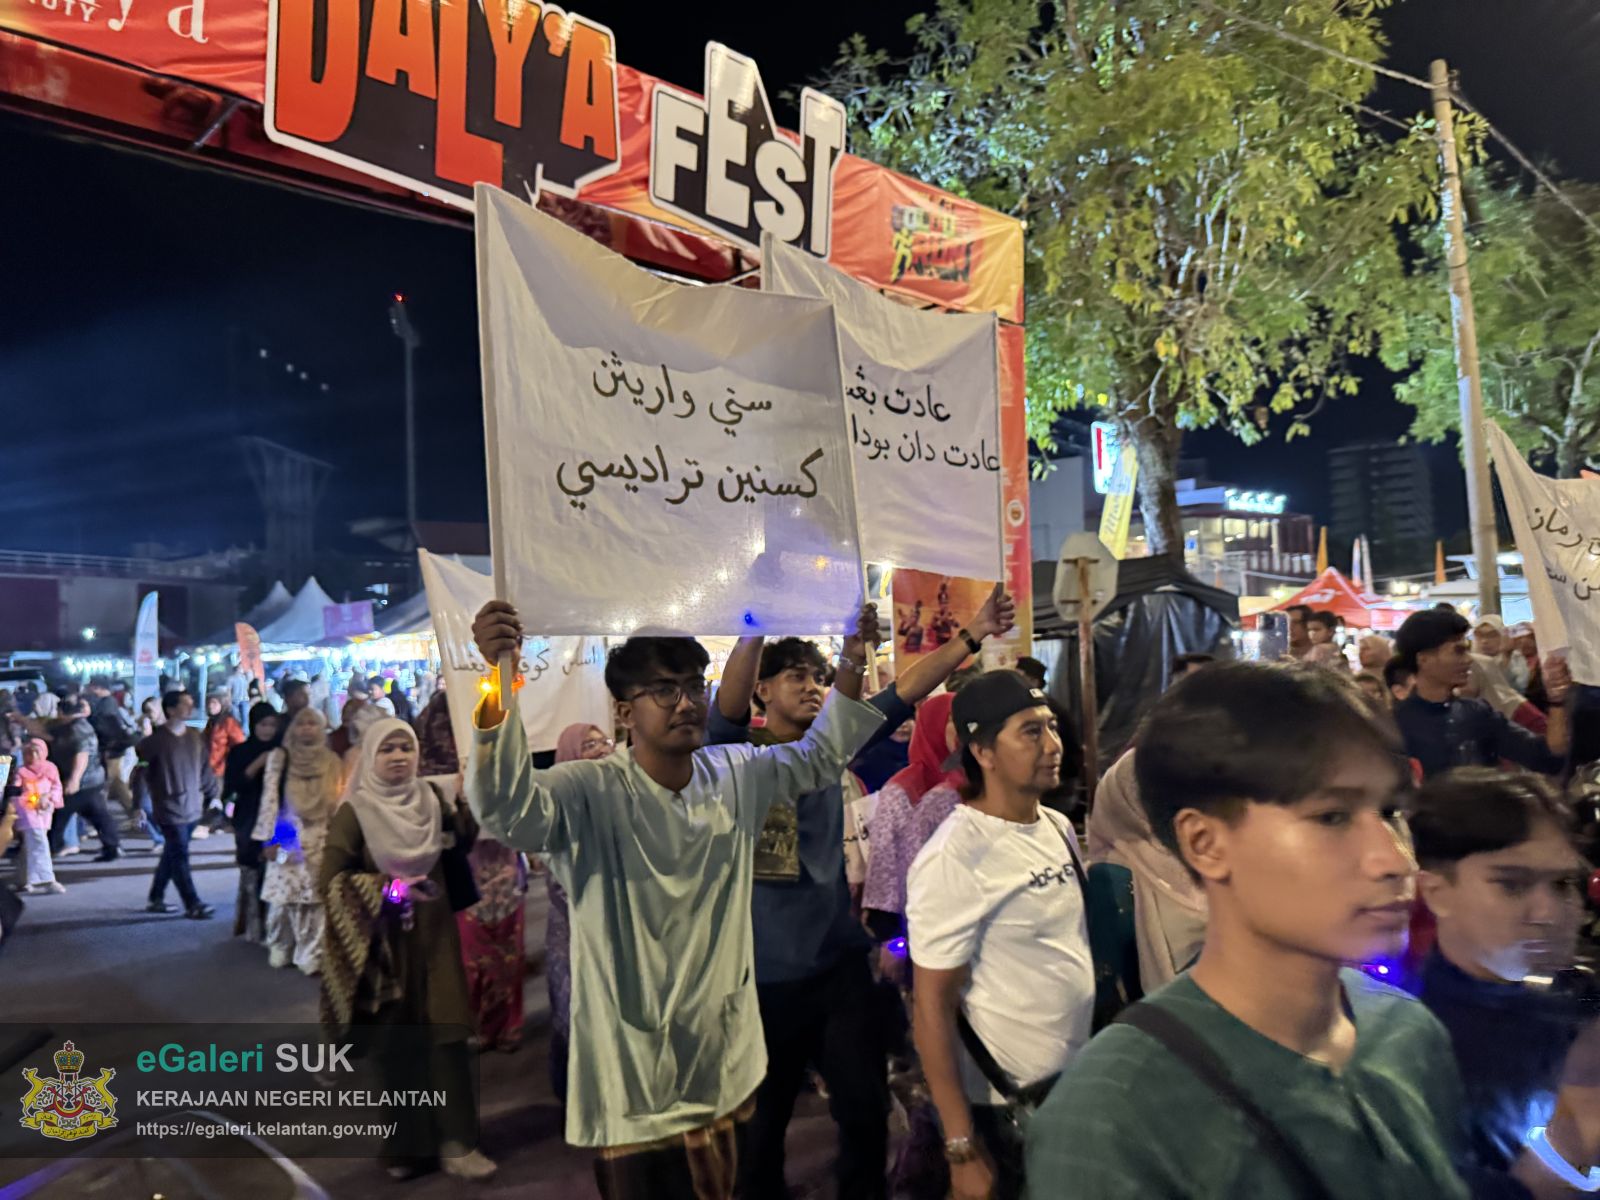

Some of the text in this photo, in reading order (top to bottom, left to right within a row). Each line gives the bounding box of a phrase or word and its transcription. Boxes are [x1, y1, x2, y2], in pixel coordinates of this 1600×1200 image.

[654, 48, 842, 257] FEST
[884, 384, 951, 422] عادت
[897, 430, 936, 463] دان
[943, 438, 1001, 472] عادت
